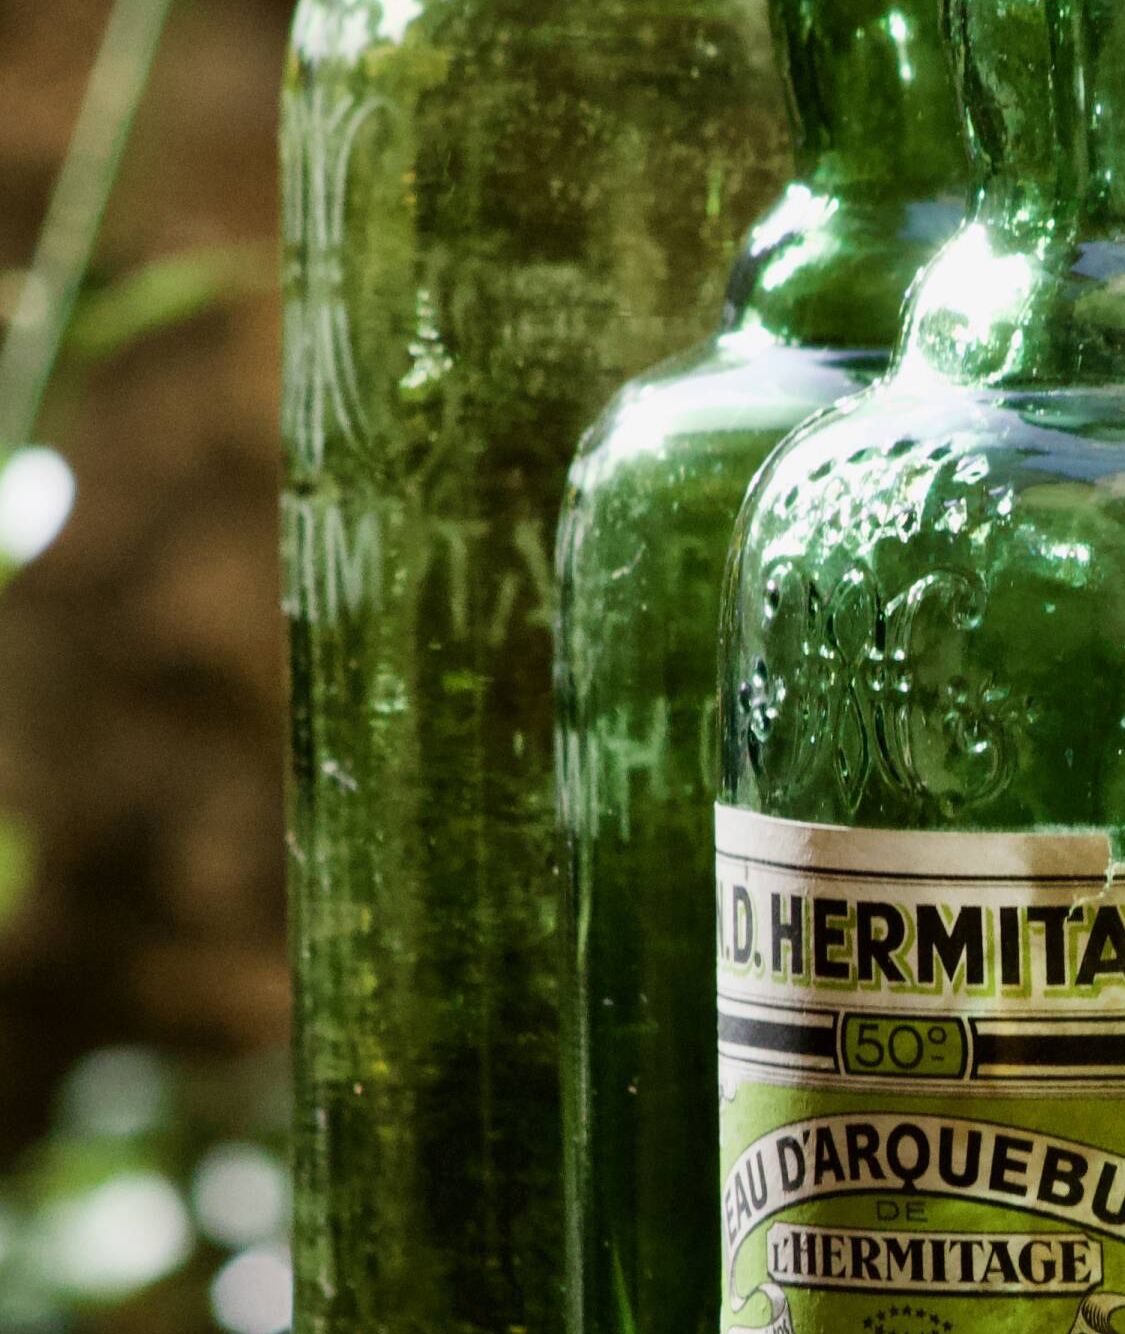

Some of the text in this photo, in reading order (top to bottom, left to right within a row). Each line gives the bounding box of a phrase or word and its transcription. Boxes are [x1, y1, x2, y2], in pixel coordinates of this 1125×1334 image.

[723, 1152, 770, 1243] EAU
[876, 1200, 929, 1223] DE
[773, 1230, 1093, 1286] L'HERMITAGE
